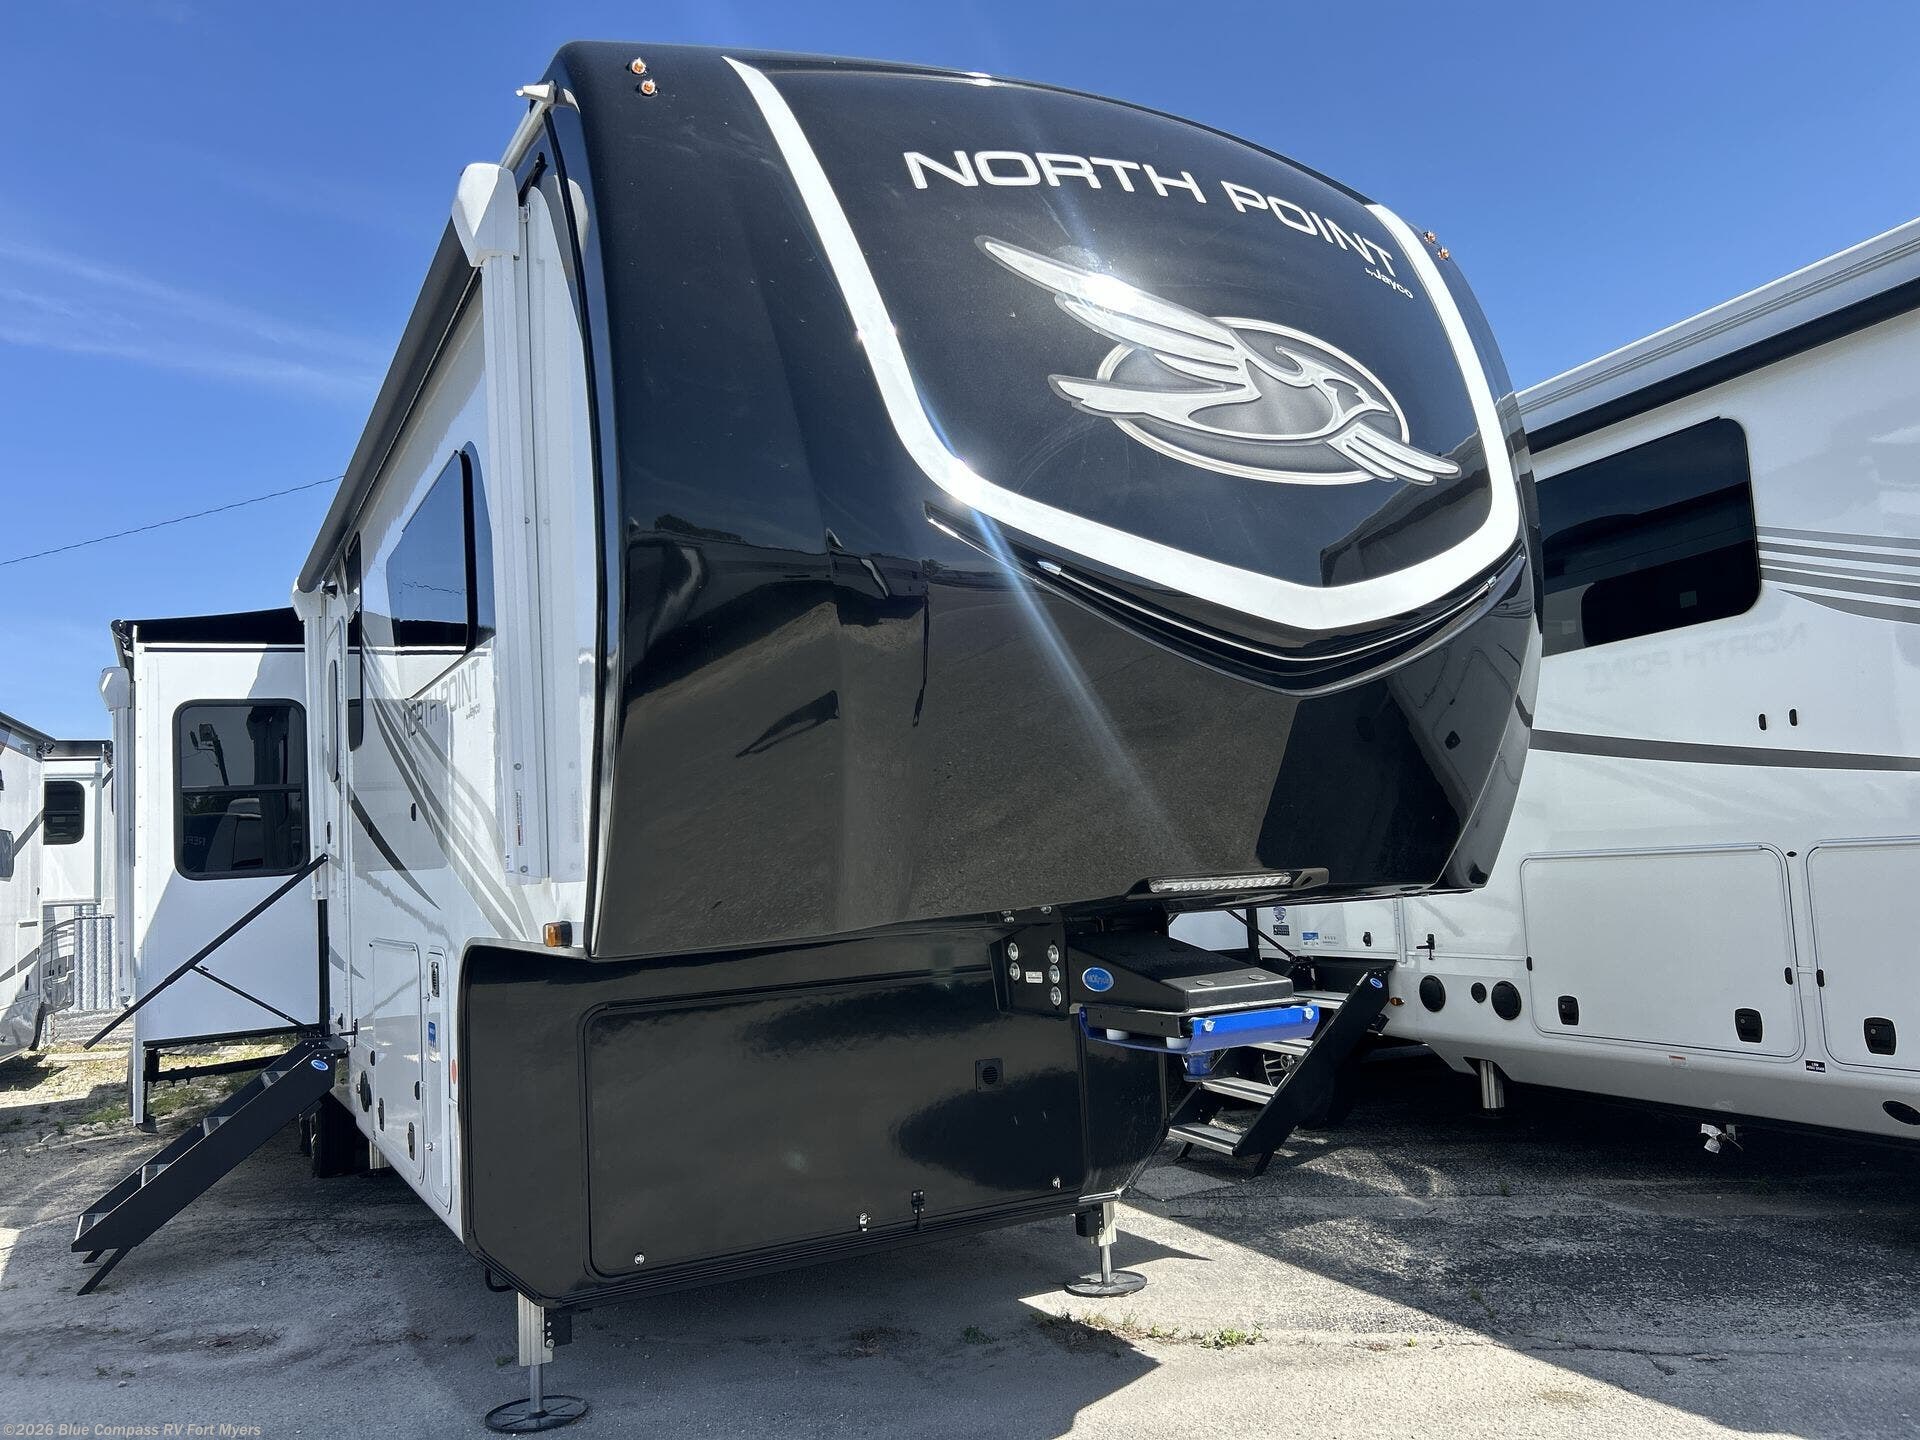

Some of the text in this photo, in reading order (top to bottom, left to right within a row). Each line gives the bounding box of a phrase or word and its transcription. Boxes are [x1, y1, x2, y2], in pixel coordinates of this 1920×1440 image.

[903, 149, 1397, 277] NORTH POINT
[1373, 269, 1414, 299] Jayco
[441, 658, 480, 717] POINT
